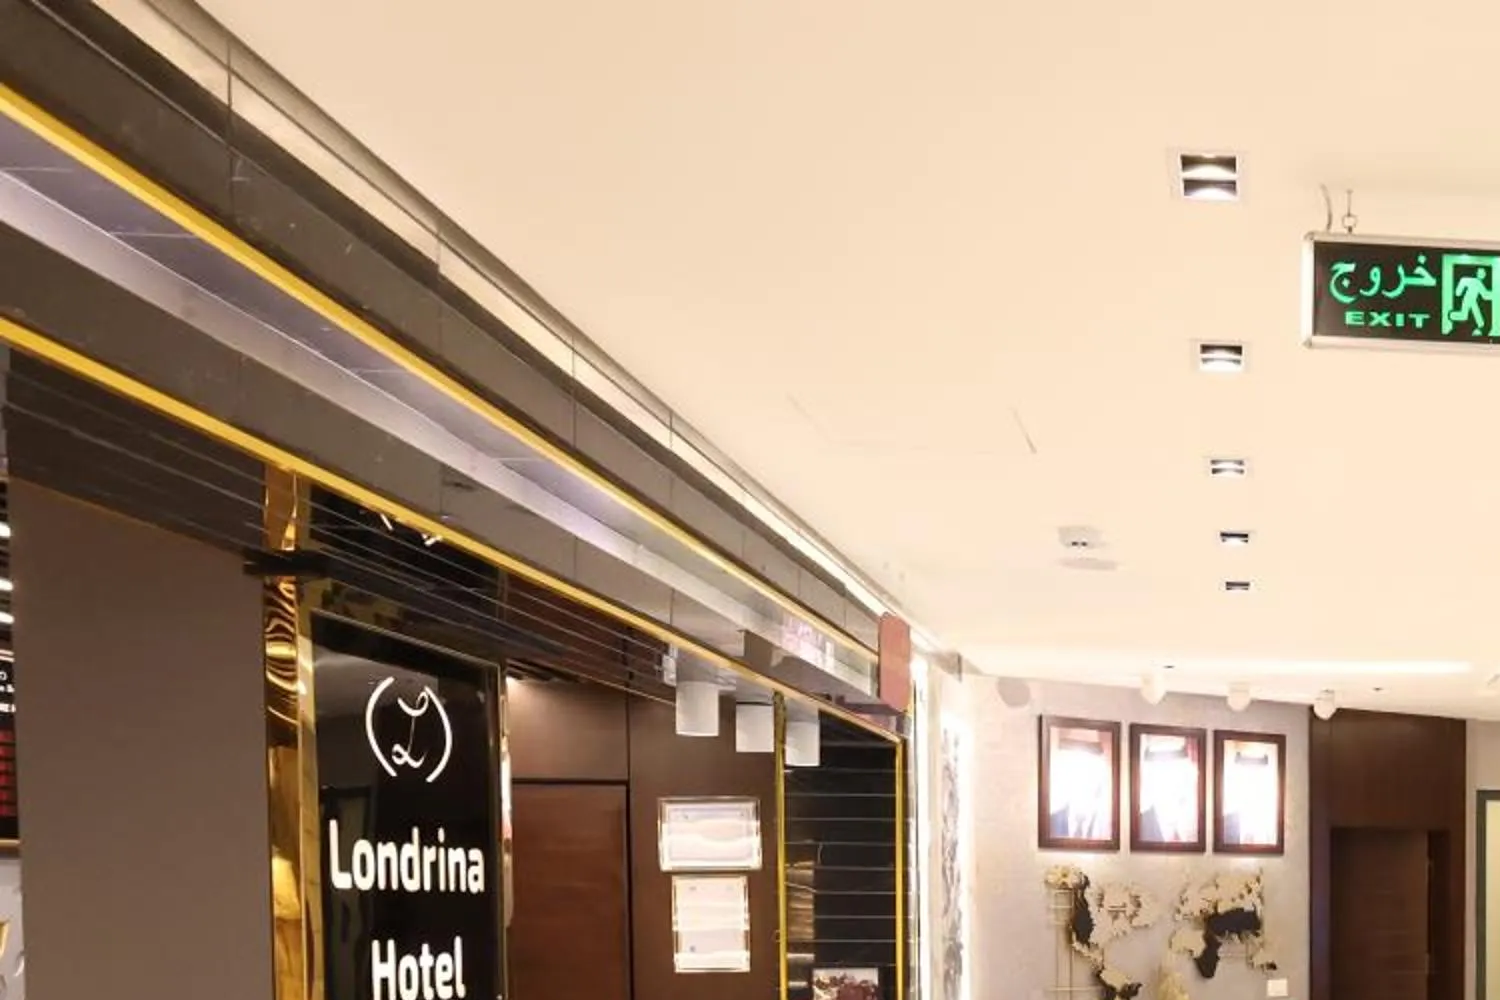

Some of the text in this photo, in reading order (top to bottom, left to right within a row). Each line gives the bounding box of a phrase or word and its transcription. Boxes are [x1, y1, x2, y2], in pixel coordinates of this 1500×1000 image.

[1328, 254, 1437, 304] خروج
[1344, 310, 1431, 329] EXIT
[328, 819, 486, 894] Londrina
